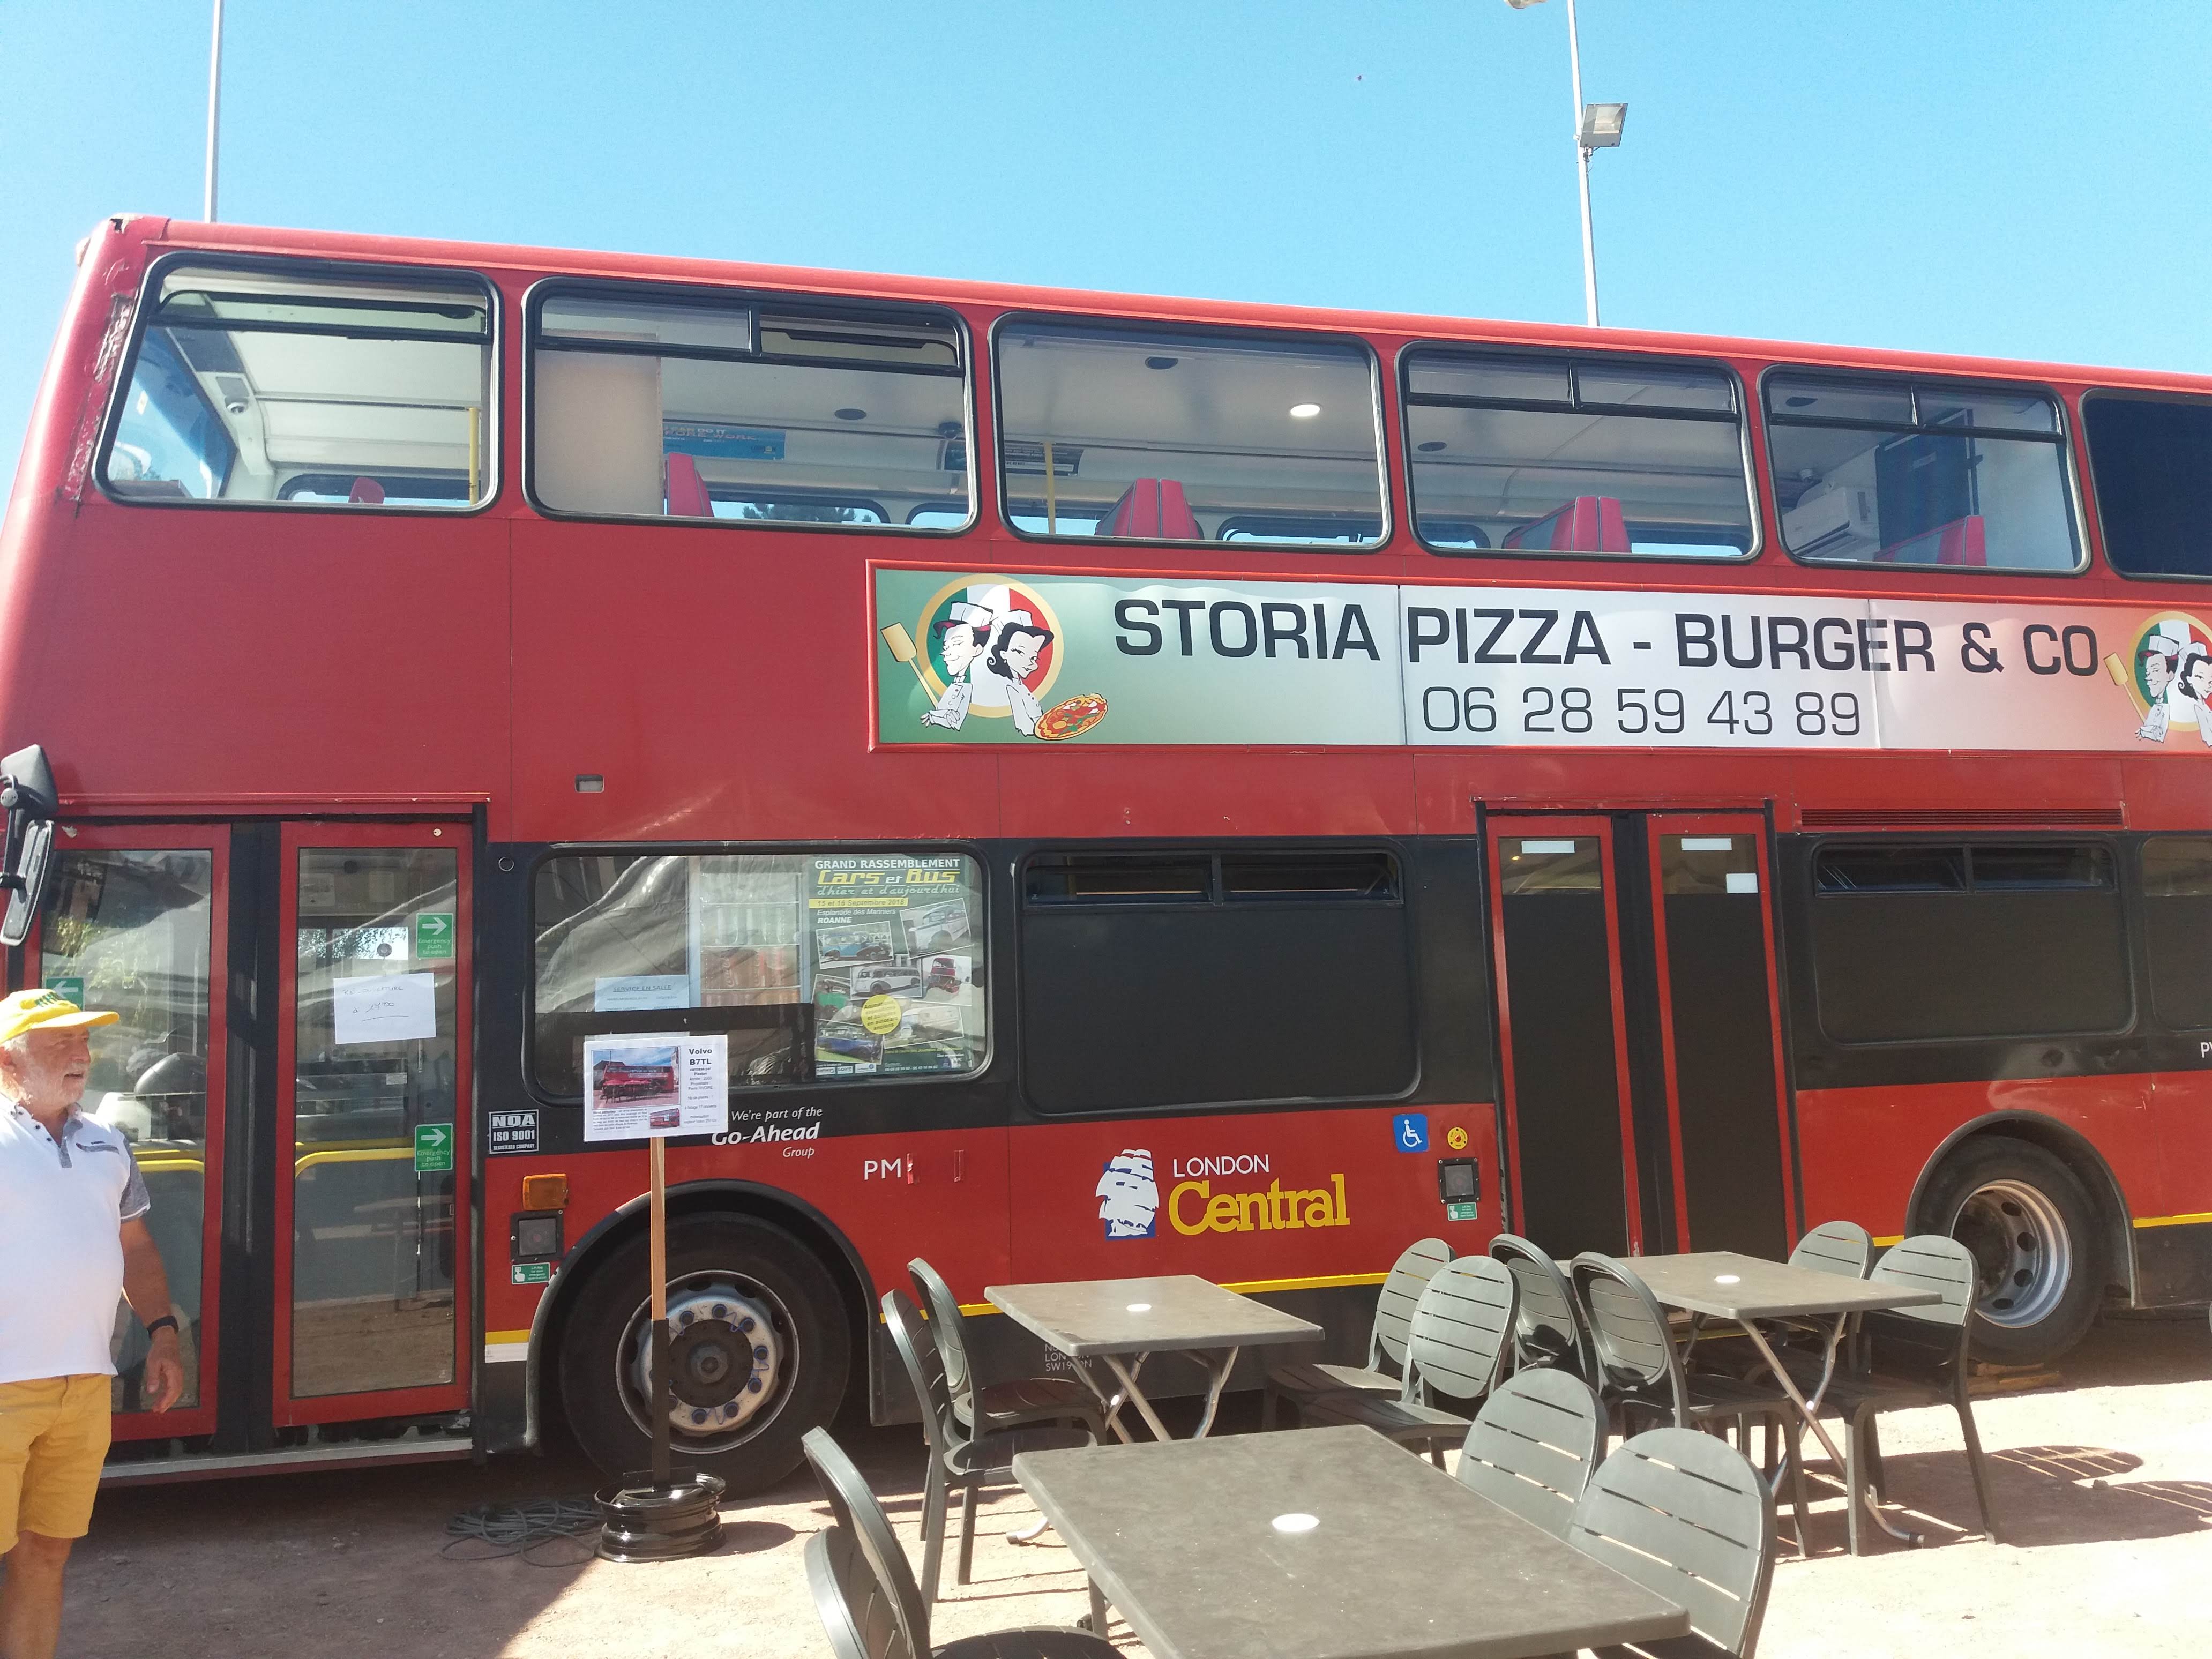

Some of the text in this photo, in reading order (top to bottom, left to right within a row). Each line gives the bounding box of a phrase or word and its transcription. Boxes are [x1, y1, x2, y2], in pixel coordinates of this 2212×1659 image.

[1114, 599, 2098, 677] STORIA PIZZA - BURGER & CO
[1423, 687, 1861, 736] 06 28 59 43 89
[814, 858, 960, 869] GRAND RASSEMBLEMENT
[817, 869, 960, 884] Cars et Bus
[817, 886, 855, 895] d'hier
[879, 885, 960, 897] d'aujourd'hui
[731, 1107, 823, 1122] We're part of the
[493, 1130, 535, 1142] ISO 9001
[712, 1122, 820, 1146] Go-Ahead
[783, 1146, 815, 1159] Group
[864, 1158, 901, 1180] PM
[1174, 1154, 1269, 1177] LONDON
[1169, 1174, 1350, 1236] Central
[1045, 1361, 1072, 1372] SW19
